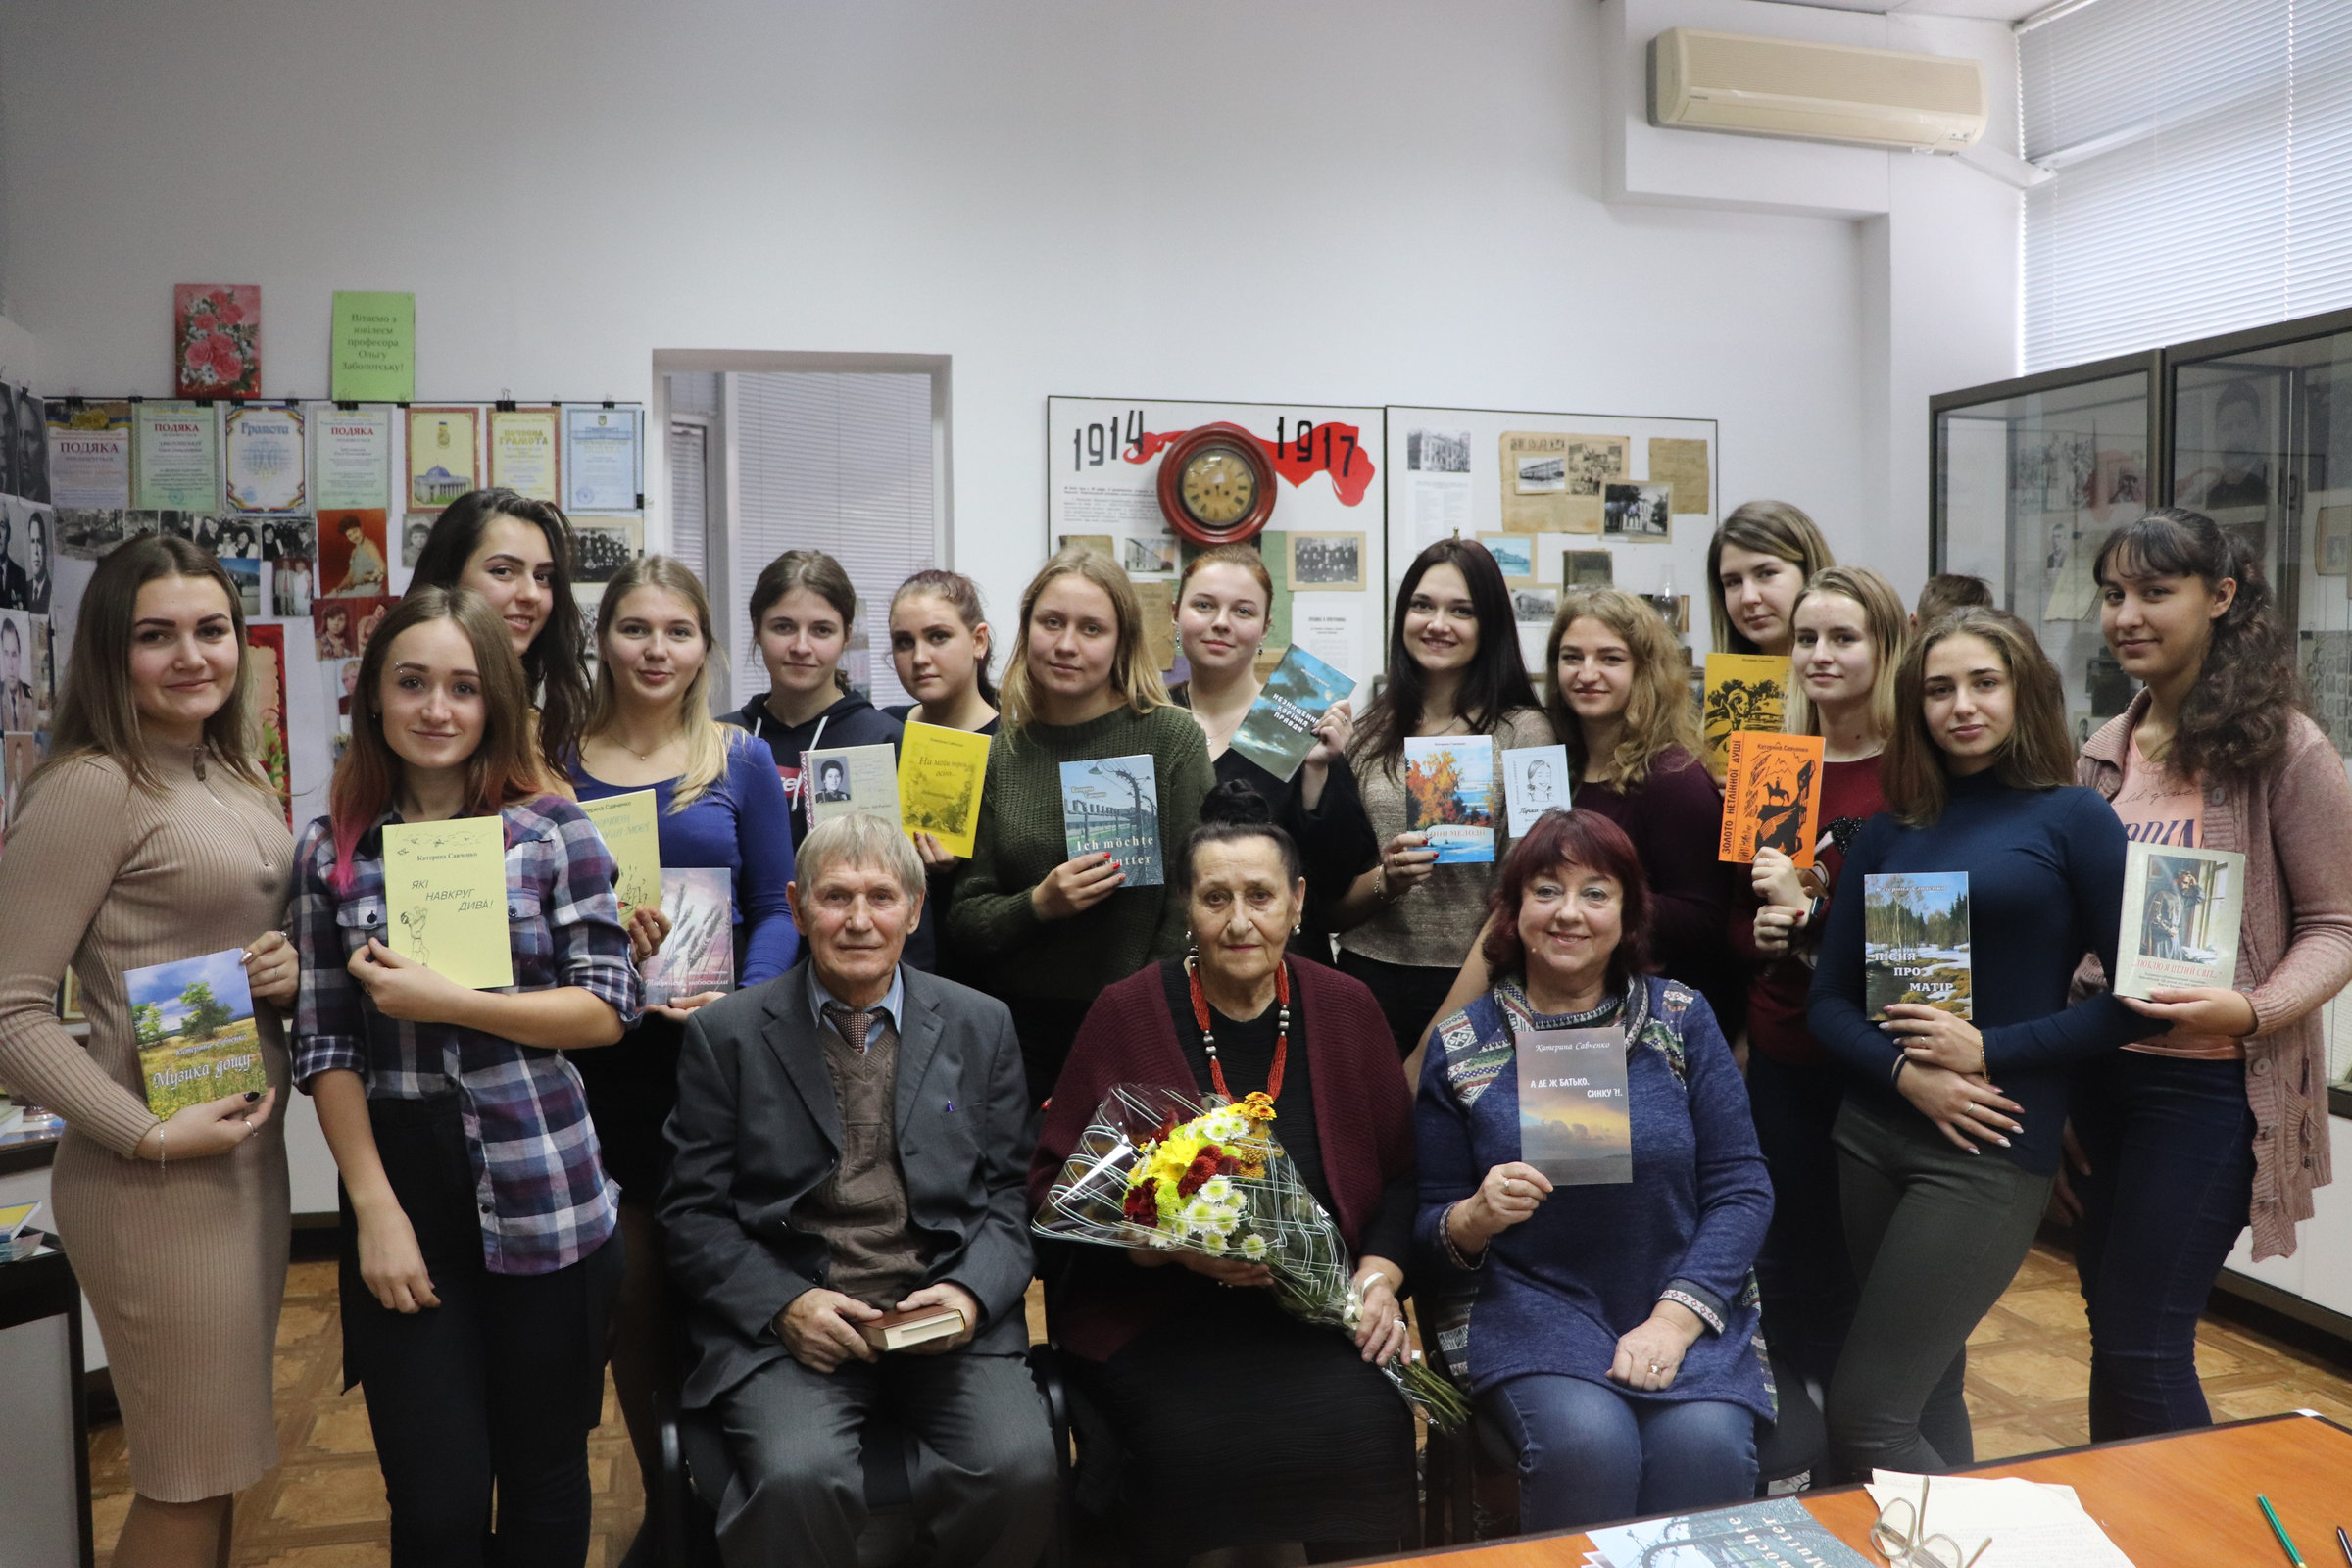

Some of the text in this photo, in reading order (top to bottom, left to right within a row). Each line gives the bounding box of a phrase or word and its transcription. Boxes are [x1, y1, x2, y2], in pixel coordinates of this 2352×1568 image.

[352, 314, 390, 322] Вітаємо
[348, 338, 398, 348] професора
[358, 350, 387, 360] Ольгу
[154, 424, 199, 432] ПОДЯКА
[241, 423, 289, 436] Грамота
[331, 427, 374, 436] ПОДЯКА
[1073, 410, 1145, 471] 1914
[60, 442, 119, 454] ПОДЯКА
[1277, 416, 1355, 477] 1917
[1274, 711, 1304, 733] ПРАВДИ
[1722, 820, 1732, 854] ЗОЛОТО
[1077, 835, 1154, 852] Ich möchte
[417, 851, 478, 862] Катерина Савченко
[411, 880, 429, 889] ЯКІ
[426, 888, 475, 901] НАВКРУГ
[458, 899, 493, 913] ДИВА!
[1874, 952, 1916, 961] ПІСНЯ
[1894, 967, 1921, 977] ПРО
[1910, 982, 1954, 991] МАТІР
[1535, 1041, 1611, 1053] Катерина Савченко
[152, 1054, 251, 1090] Музика дощу
[1531, 1080, 1536, 1088] А
[1538, 1079, 1547, 1088] ДЕ
[1587, 1089, 1612, 1098] СИНКУ
